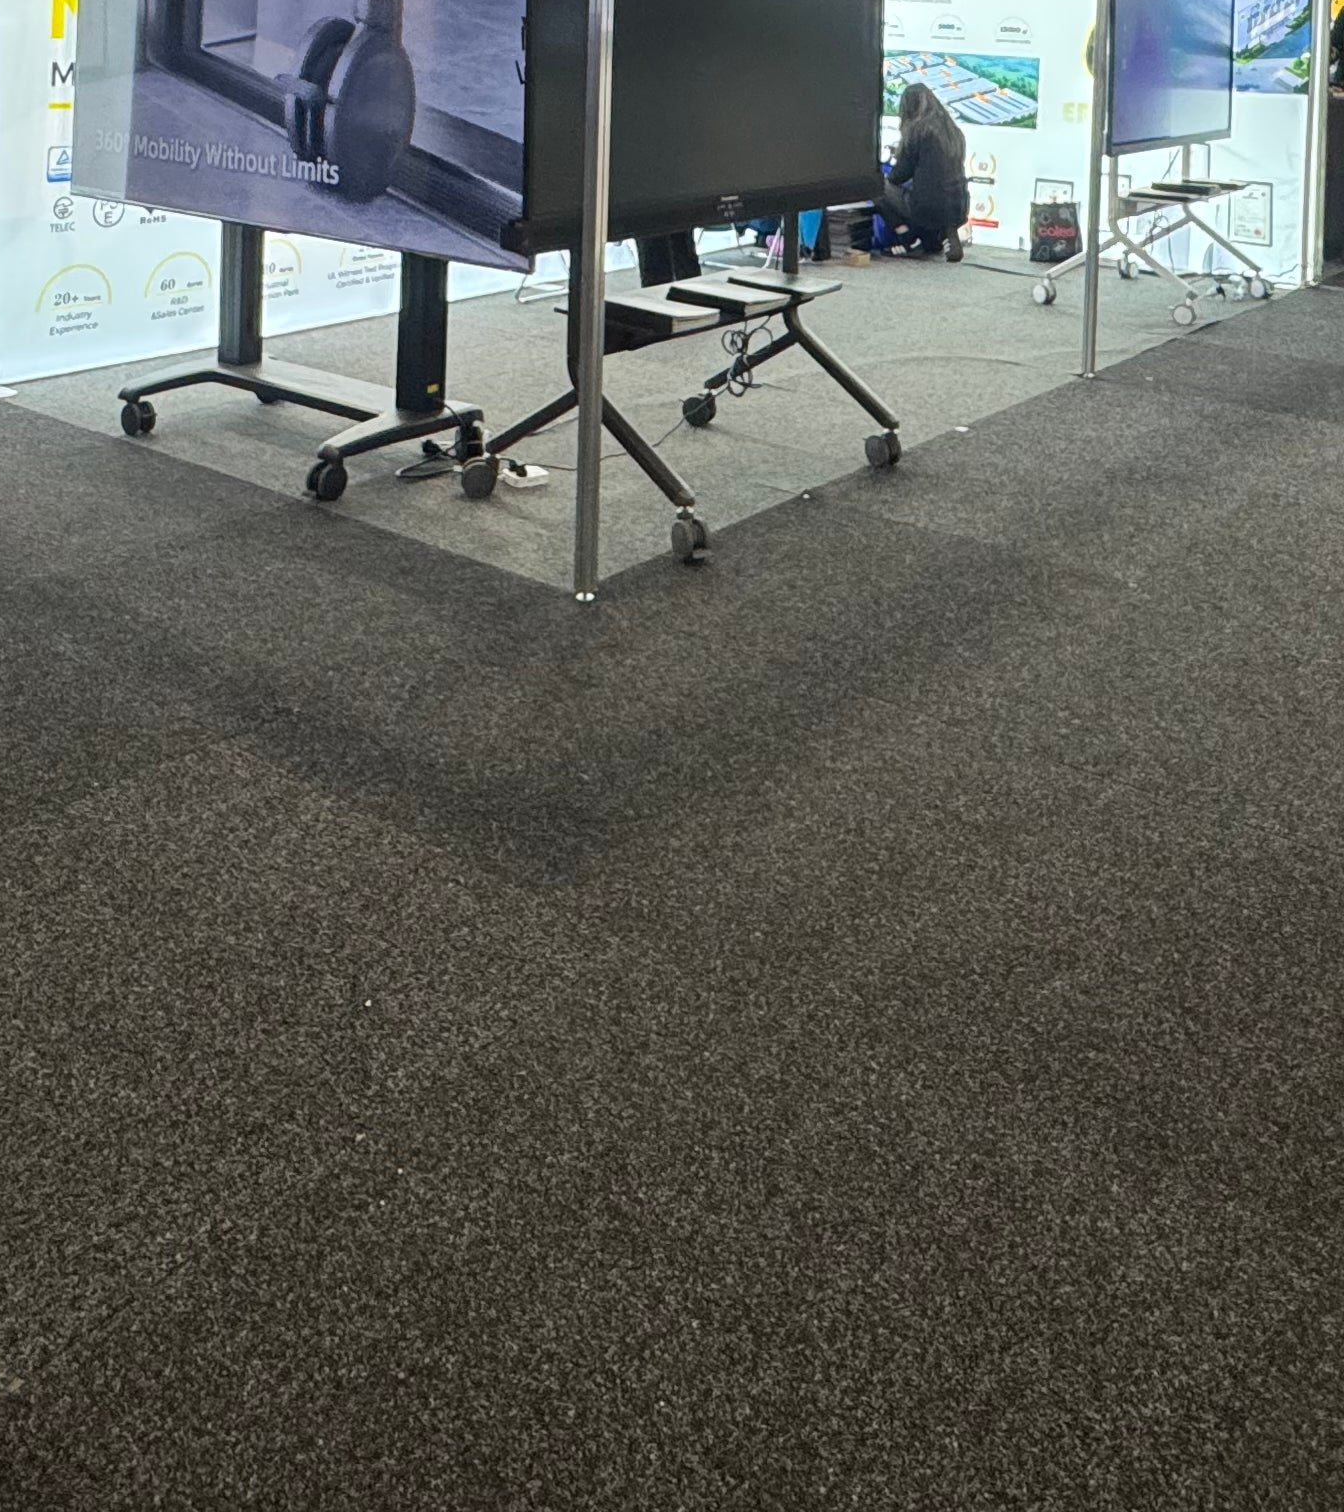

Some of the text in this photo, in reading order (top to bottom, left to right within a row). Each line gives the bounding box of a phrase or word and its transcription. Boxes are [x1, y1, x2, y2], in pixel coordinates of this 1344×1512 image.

[133, 135, 201, 170] Mobility
[206, 143, 277, 177] Without
[282, 153, 340, 185] Limits
[50, 221, 76, 233] TELEC
[53, 292, 79, 306] 20+
[55, 311, 93, 324] Industry
